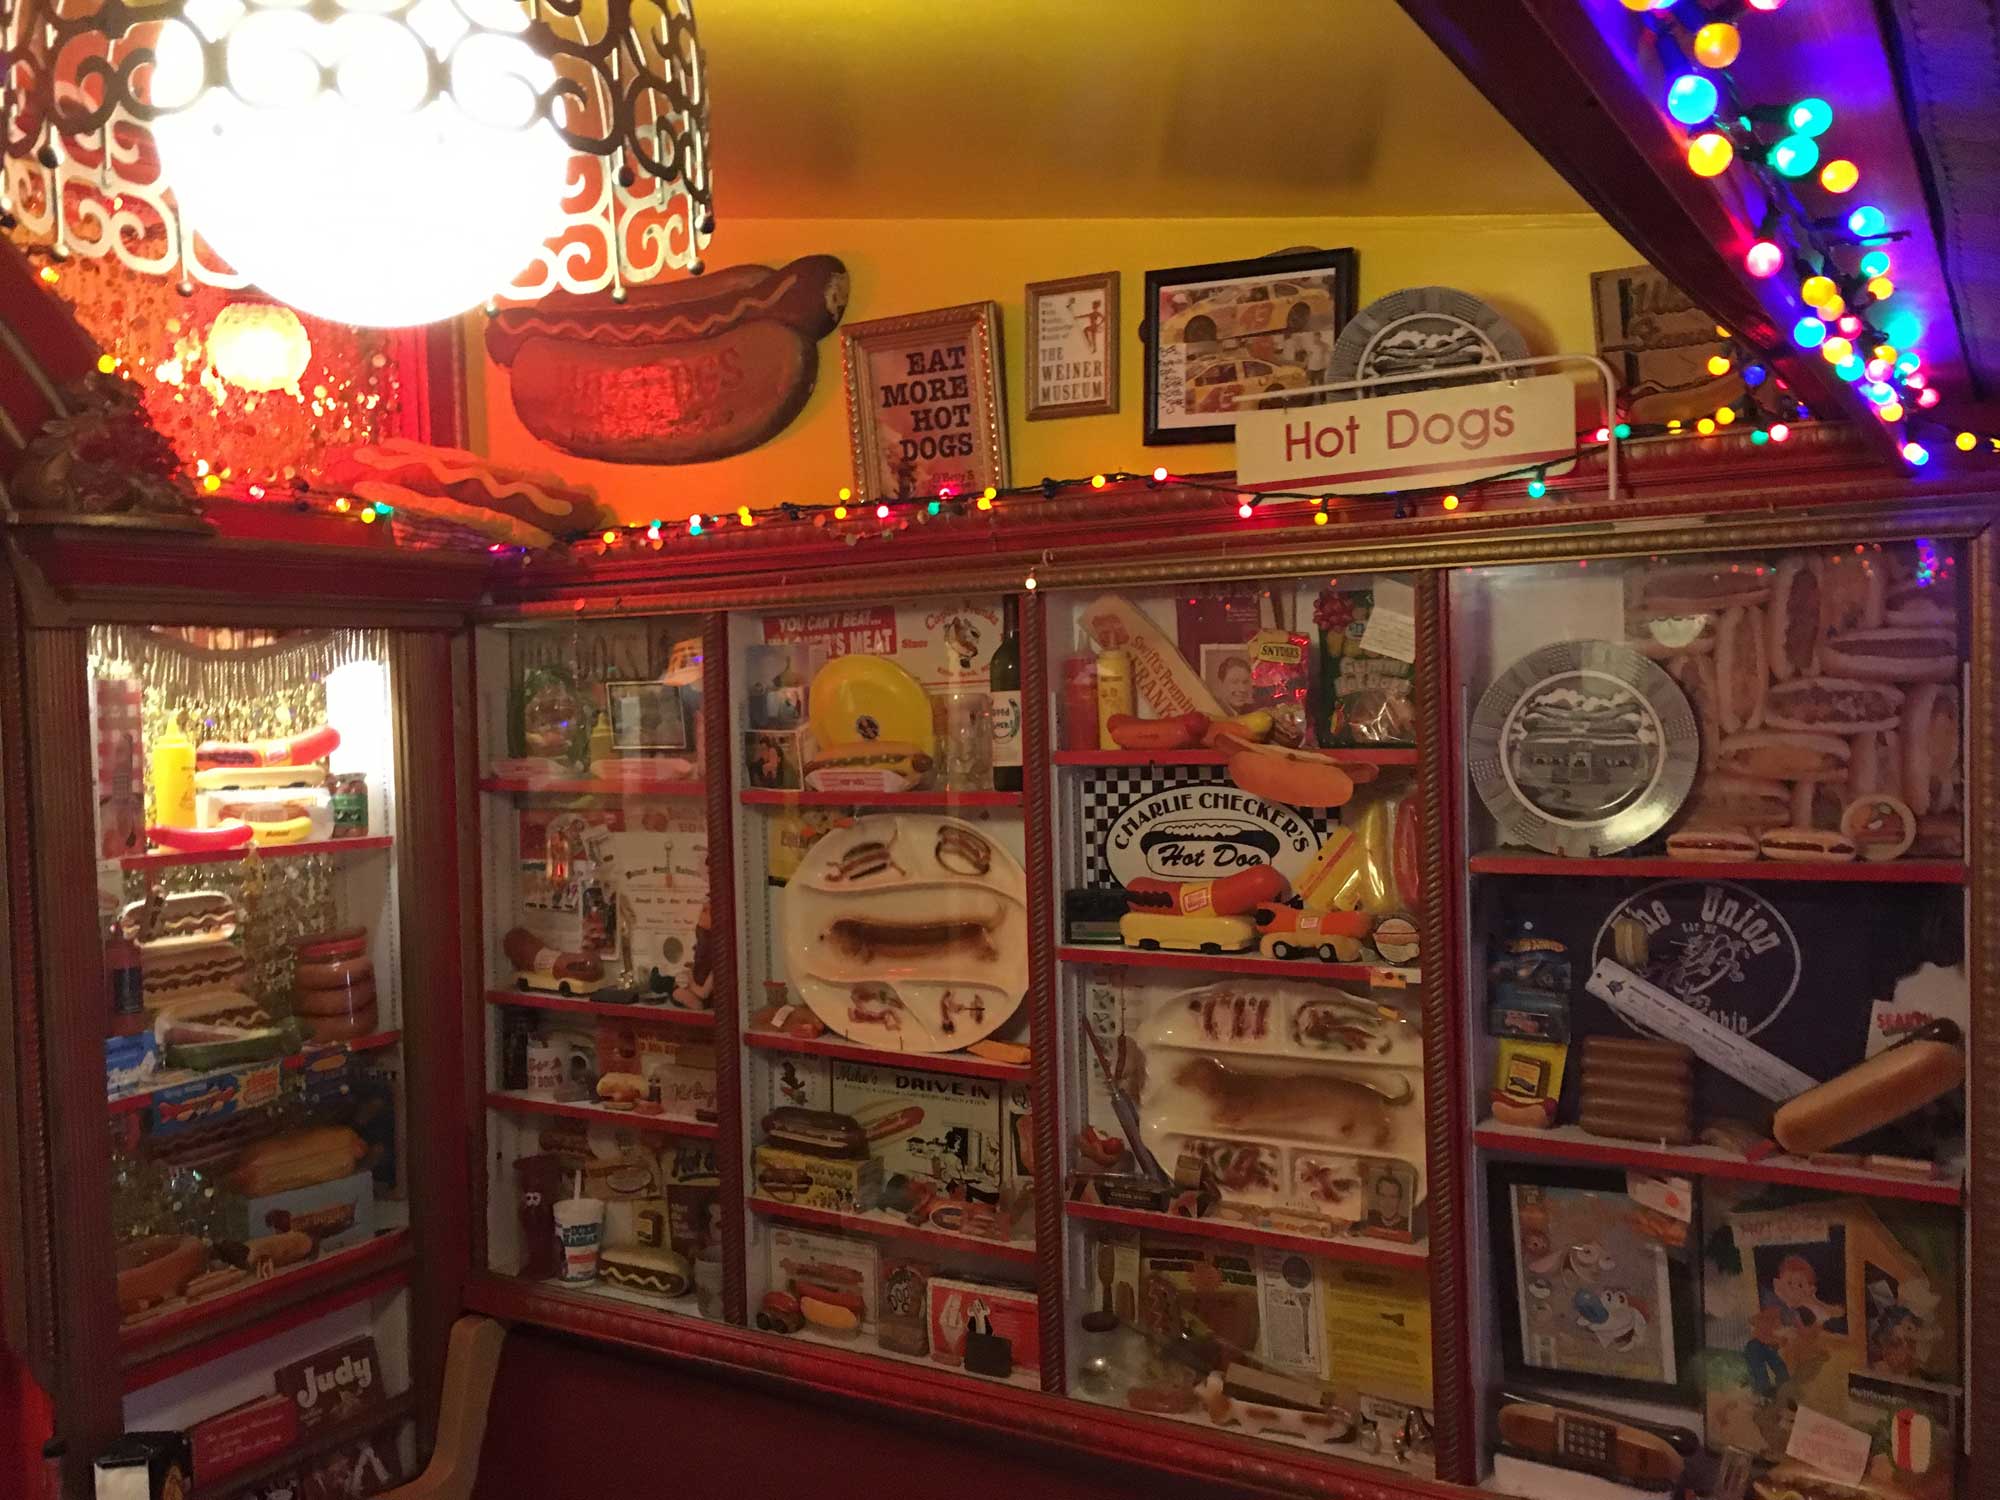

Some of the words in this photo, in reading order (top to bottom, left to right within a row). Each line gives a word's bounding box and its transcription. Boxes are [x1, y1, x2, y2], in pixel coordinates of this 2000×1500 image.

[906, 346, 966, 376] EAT
[1041, 347, 1064, 362] THE
[1041, 360, 1103, 382] WEINER
[880, 375, 969, 408] MORE
[1040, 381, 1103, 403] MUSEUM
[911, 404, 971, 433] HOT
[1285, 415, 1360, 462] Hot
[1386, 404, 1515, 450] Dogs
[899, 433, 973, 463] DOGS
[777, 615, 804, 633] YOU
[849, 628, 893, 656] MEAT
[1114, 793, 1194, 850] CHARLIE
[1198, 792, 1310, 853] CHECKER'S
[1157, 843, 1205, 867] Hot
[1611, 899, 1672, 935] he
[1701, 885, 1781, 955] Union
[895, 1074, 965, 1096] DRIVE
[971, 1084, 991, 1099] IN
[297, 1355, 373, 1409] Judy
